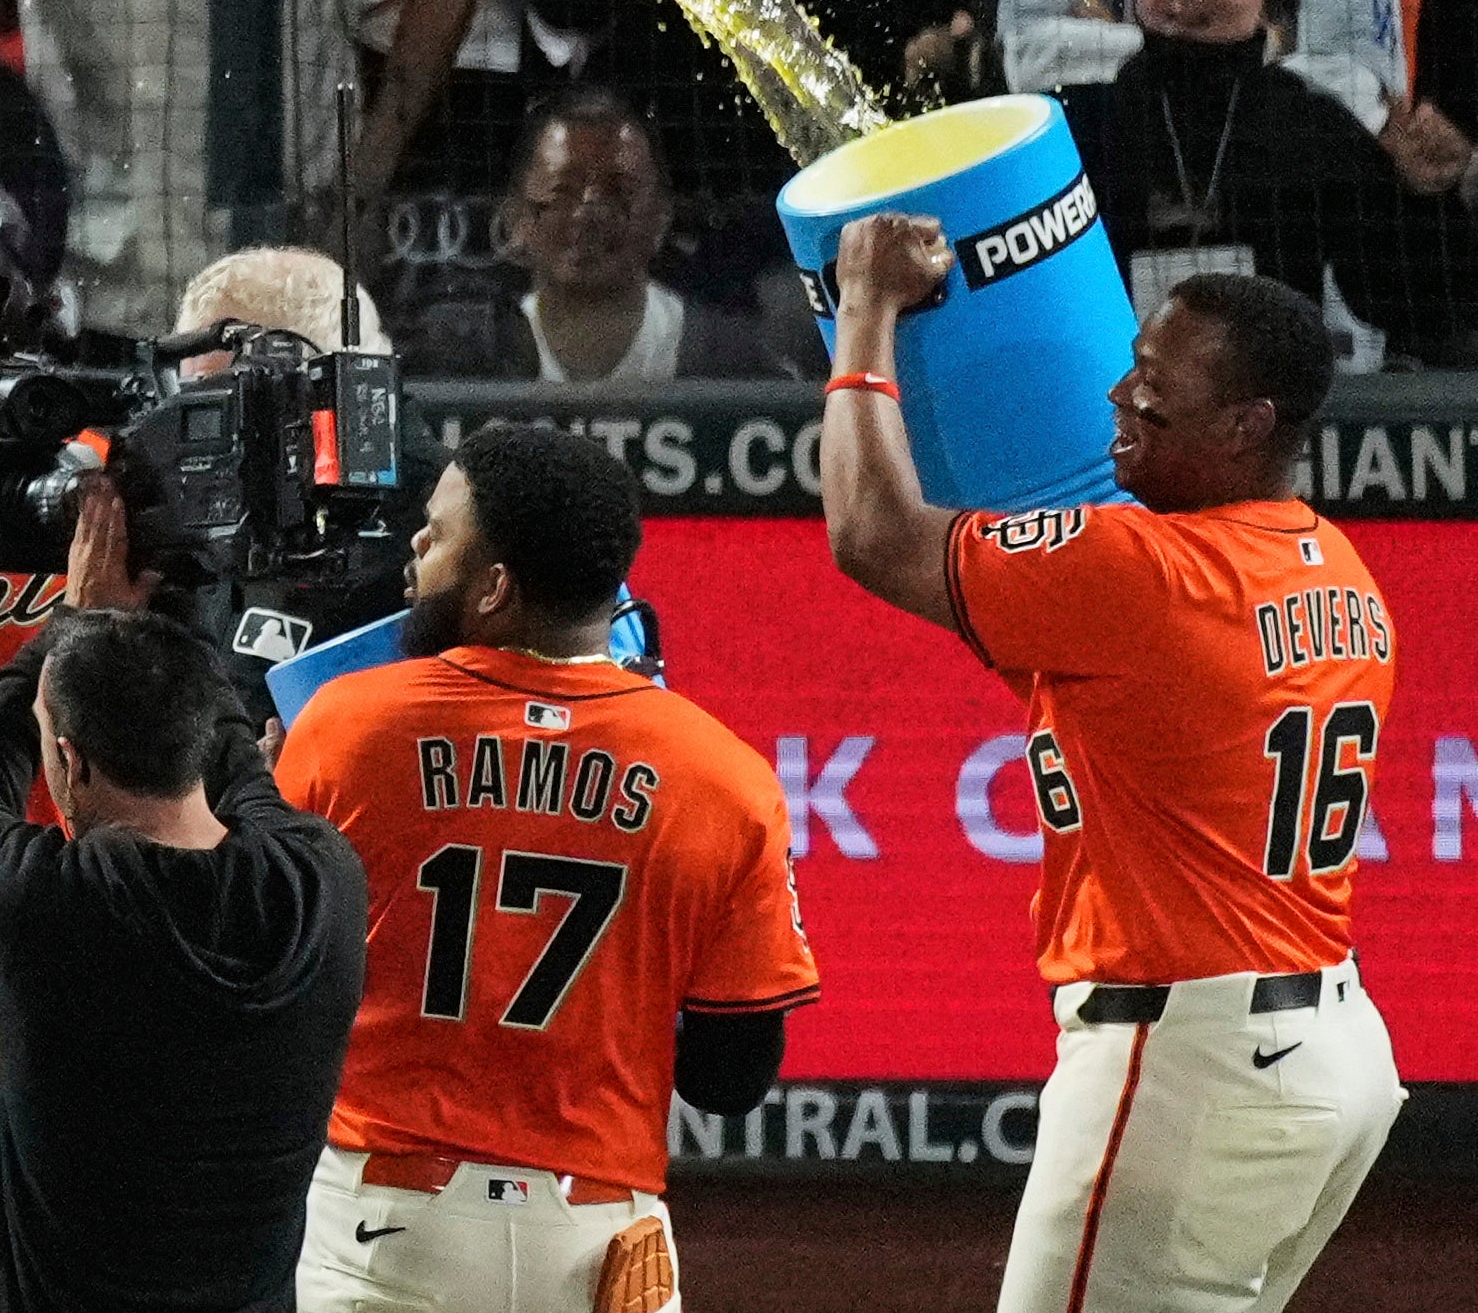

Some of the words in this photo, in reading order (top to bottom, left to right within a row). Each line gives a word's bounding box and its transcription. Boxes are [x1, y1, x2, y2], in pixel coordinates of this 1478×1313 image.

[1292, 425, 1478, 502] IAN
[1255, 585, 1393, 677] DEVERS
[416, 734, 660, 834] RAMOS
[1263, 699, 1380, 883] 16
[416, 842, 630, 1032] 17
